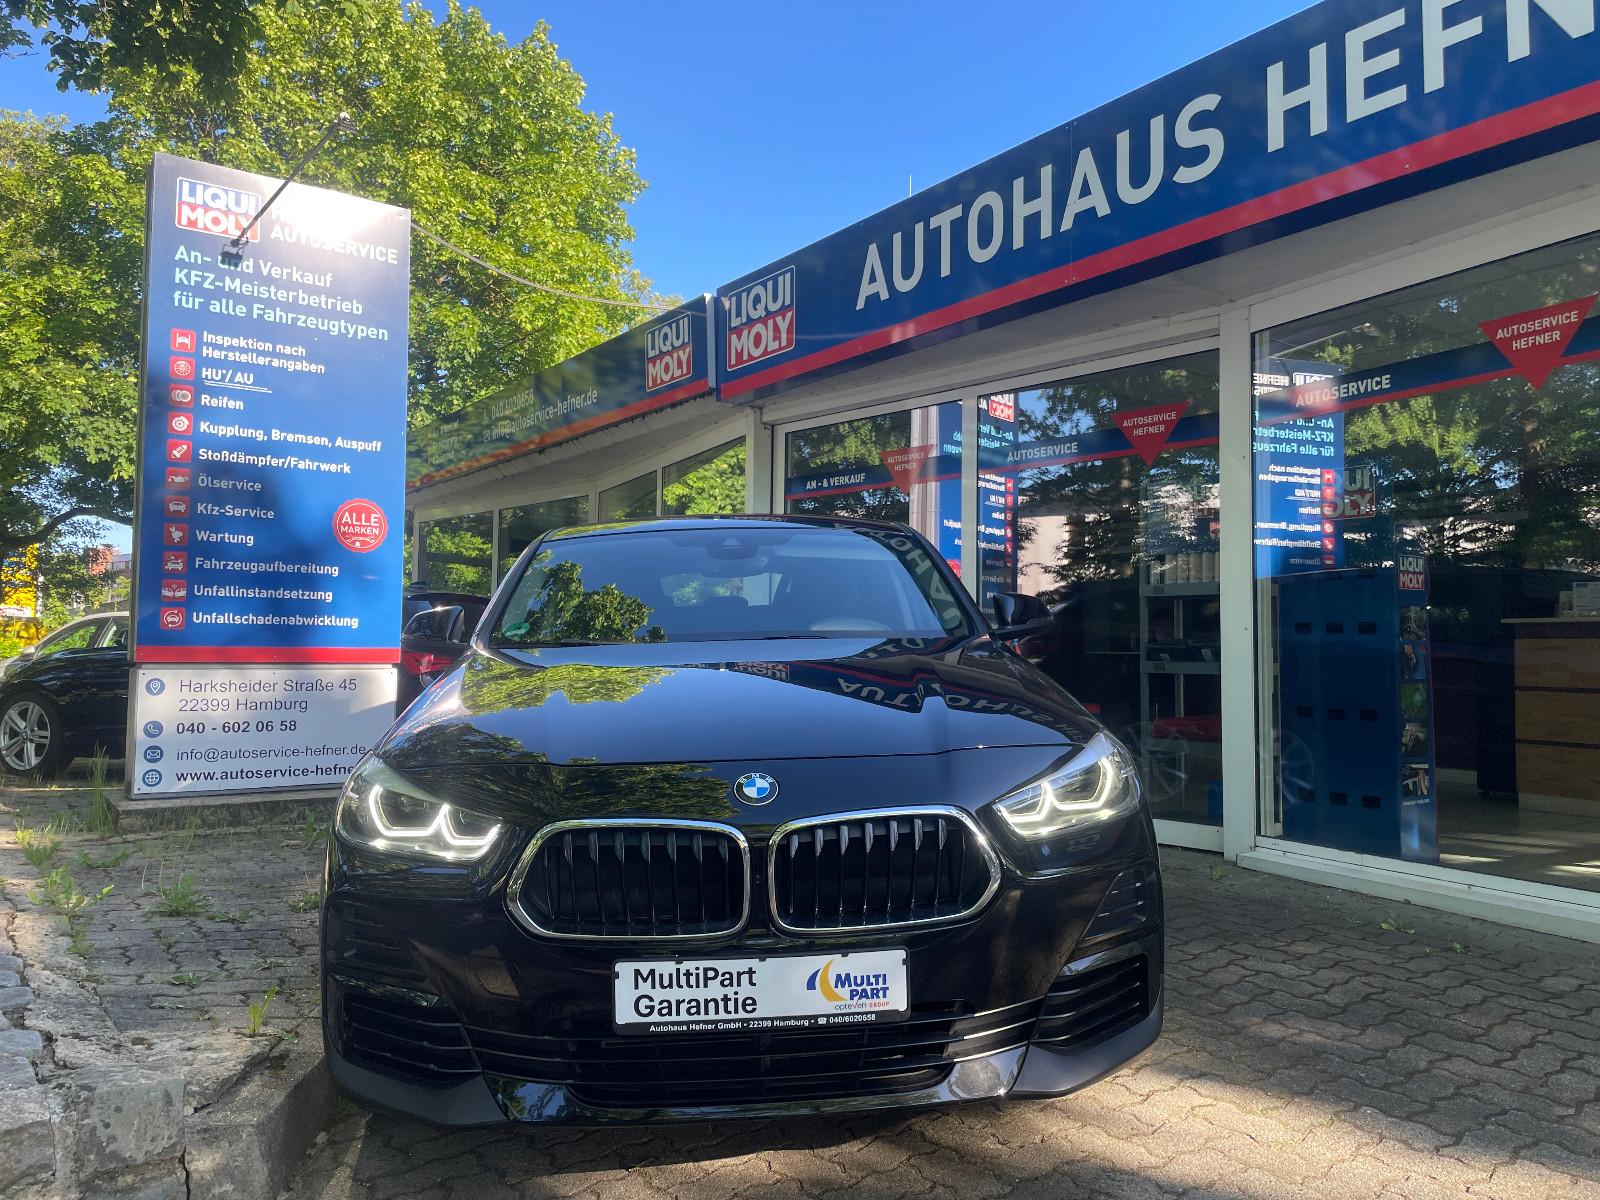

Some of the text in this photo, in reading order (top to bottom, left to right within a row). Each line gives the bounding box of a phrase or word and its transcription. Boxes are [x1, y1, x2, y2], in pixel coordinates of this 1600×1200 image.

[182, 181, 256, 215] LIQUI
[855, 93, 1225, 311] AUTOHAUS
[174, 246, 333, 288] An- ud Verkauf
[174, 268, 363, 314] KFZ-Meisterbetrieb
[731, 272, 791, 328] LIQUI
[173, 291, 389, 341] für alle Fahrzeugtypen
[1495, 310, 1579, 340] AUTOSERVICE
[203, 331, 306, 357] Inspektion nach
[647, 317, 689, 358] LIQUI
[731, 311, 793, 366] MOLY
[1512, 330, 1561, 351] HEFNER
[202, 346, 326, 374] Herstellerangaben
[648, 346, 690, 387] MOLY
[1296, 374, 1391, 408] AUTOSERVICE
[201, 394, 244, 410] Reifen
[1122, 411, 1177, 428] AUTOSERVICE
[200, 421, 382, 452] Kupplung, Bremsen, Auspuff
[1133, 424, 1165, 437] HEFNER
[198, 448, 351, 474] Stoßdämpfer/Fahrwerk
[887, 451, 925, 464] AUTOSERVICE
[1007, 442, 1078, 463] AUTOSERVICE
[894, 462, 917, 472] HEFNER
[197, 473, 262, 491] Ölservice
[830, 473, 866, 487] VERKAUF
[197, 502, 275, 519] Kfz-Service
[1322, 494, 1373, 518] OLY
[342, 512, 379, 526] ALLE
[196, 530, 254, 546] Wartung
[340, 525, 379, 535] MARKEN
[195, 557, 339, 577] Fahrzeugaufbereitung
[1400, 557, 1424, 571] LIQUI
[1400, 574, 1425, 588] MOLY
[193, 584, 333, 602] Unfallinstandsetzung
[192, 611, 359, 628] Unfallschadenabwicklung
[180, 678, 357, 694] Harksheider Straße 45
[178, 698, 308, 713] 22399 Hamburg
[176, 721, 205, 735] 040
[222, 721, 250, 734] 602
[255, 720, 274, 733] 06
[279, 720, 297, 732] 58
[176, 743, 366, 763] info@autoservice-hefner.de
[633, 966, 757, 990] MultiPart
[834, 973, 887, 989] MULTI
[850, 987, 889, 1000] PART
[633, 991, 758, 1018] Garantie
[834, 1001, 867, 1012] opteven
[649, 1013, 876, 1032] Autohaus Hefner GmbH 22399 Hamburg 040/6020658
